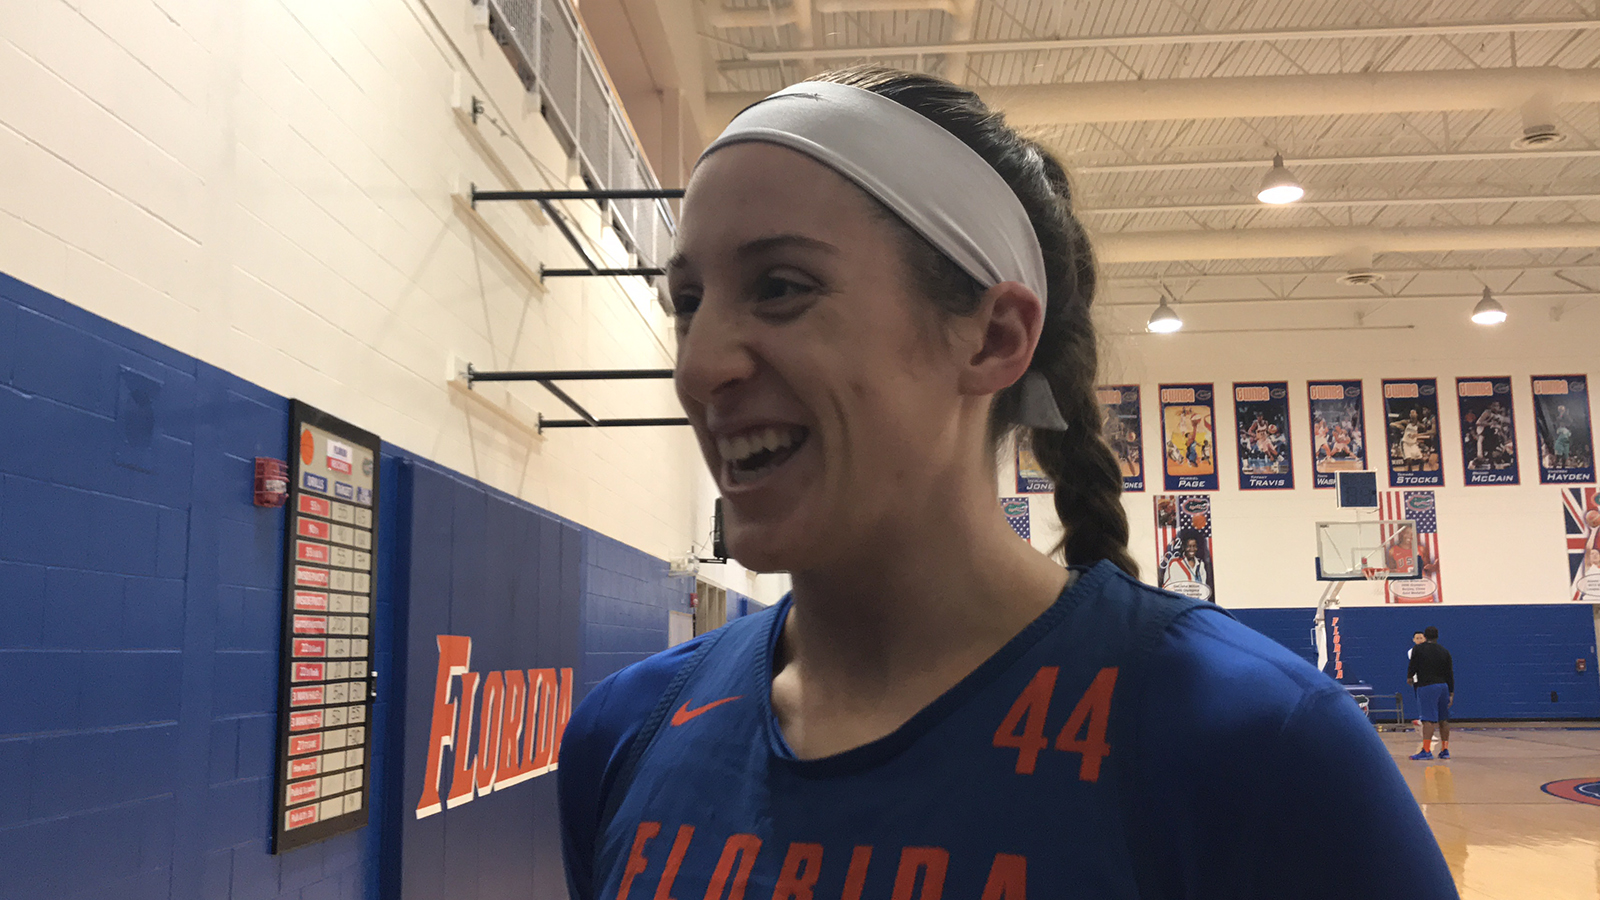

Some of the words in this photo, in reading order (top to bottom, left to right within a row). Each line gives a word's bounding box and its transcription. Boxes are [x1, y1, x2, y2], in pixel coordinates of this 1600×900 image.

[1396, 476, 1438, 484] STOCKS
[1547, 473, 1590, 481] HAYDEN
[1026, 482, 1055, 490] JONE
[1122, 481, 1143, 489] ONES
[1178, 480, 1206, 488] PAGE
[1249, 479, 1285, 487] TRAVIS
[416, 635, 573, 819] FLORIDA
[992, 665, 1119, 783] 44
[616, 821, 1027, 900] FLORIDA
